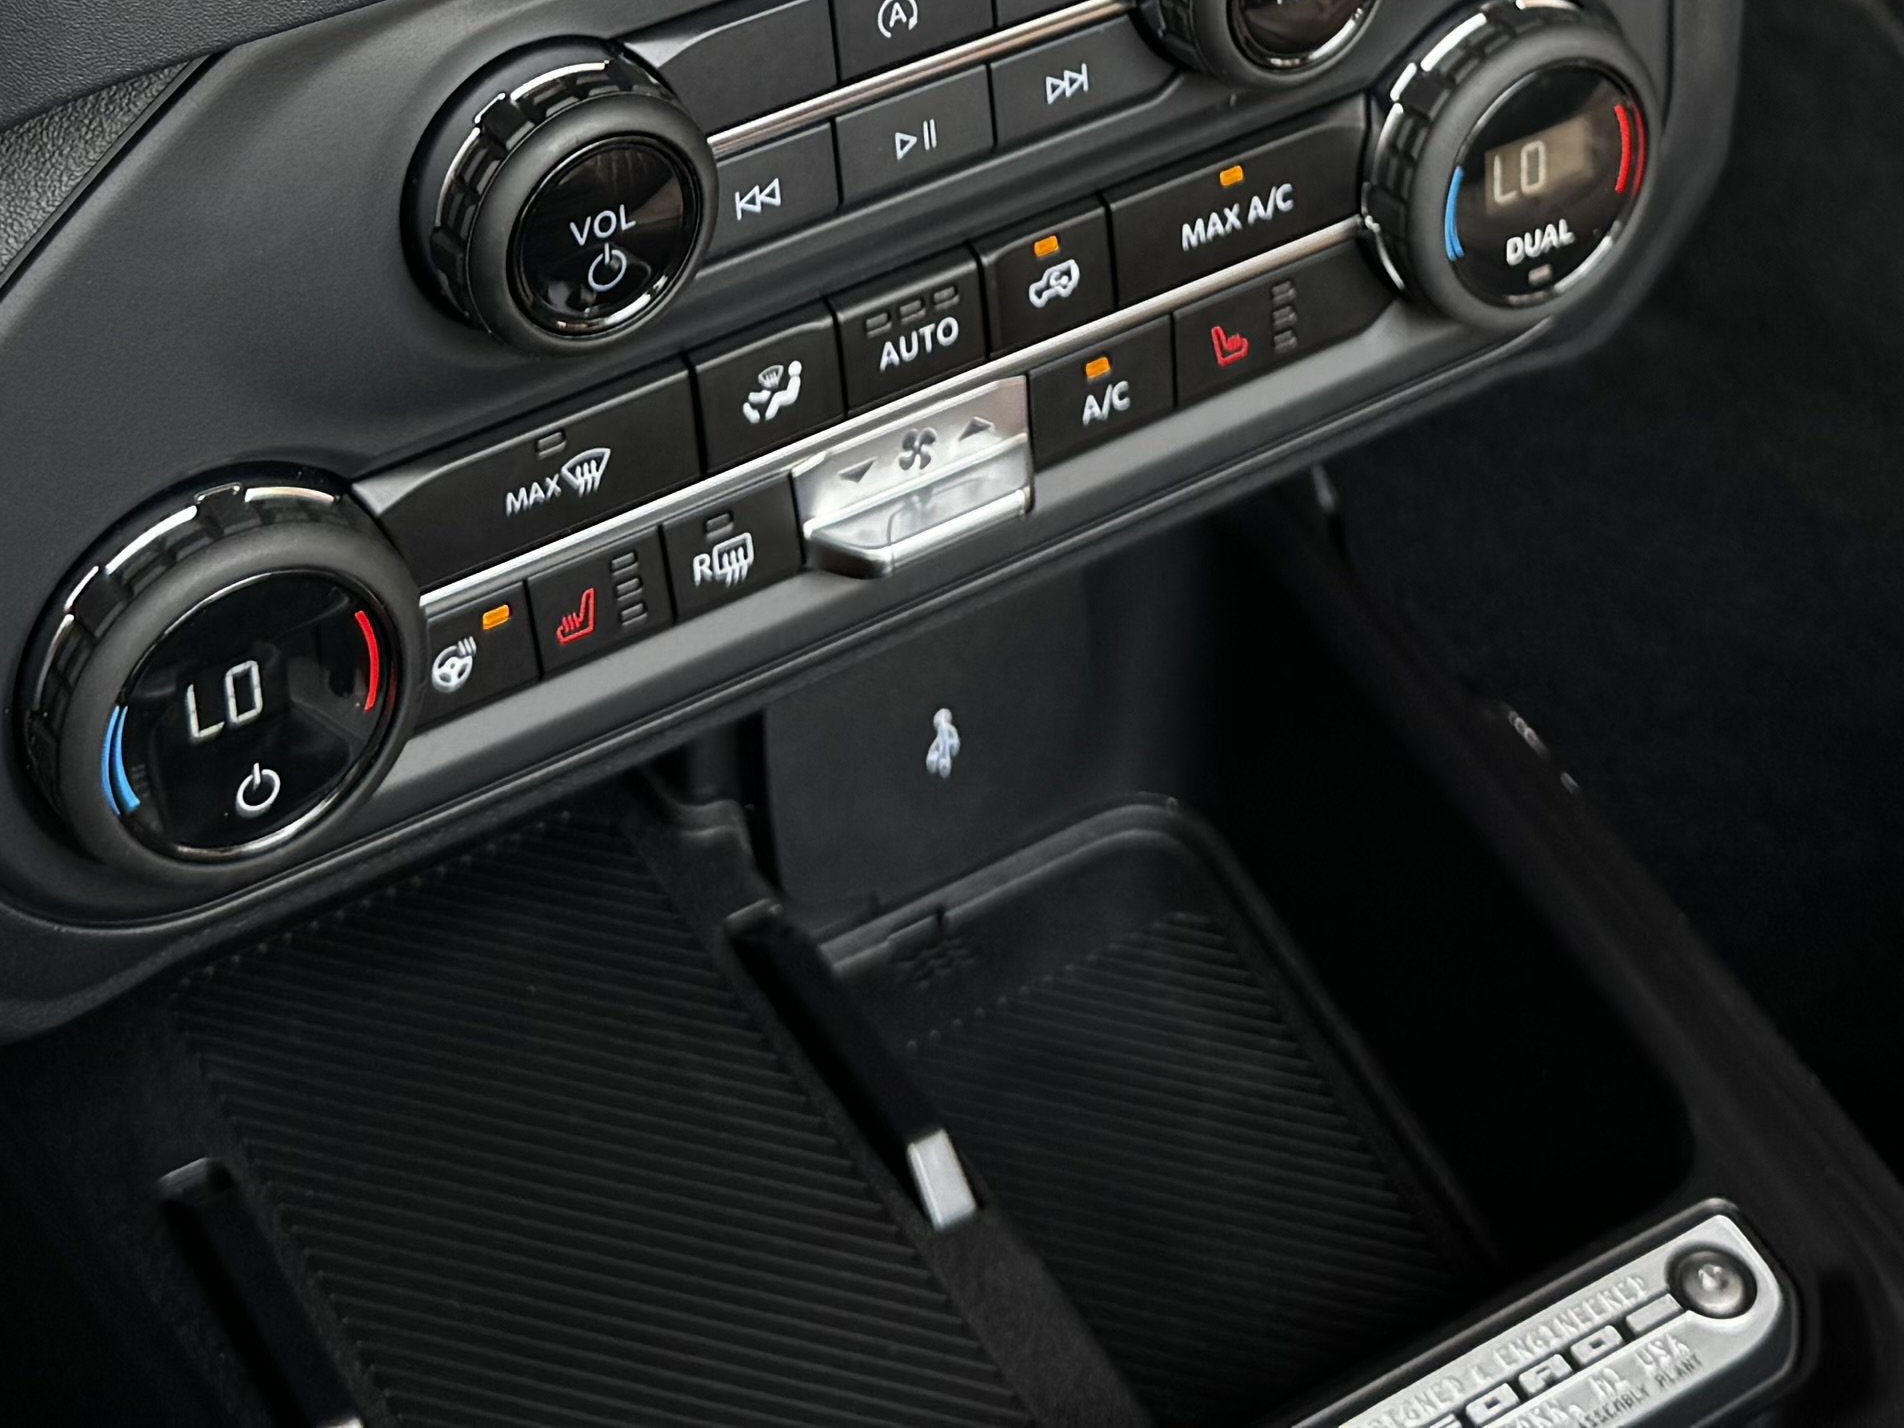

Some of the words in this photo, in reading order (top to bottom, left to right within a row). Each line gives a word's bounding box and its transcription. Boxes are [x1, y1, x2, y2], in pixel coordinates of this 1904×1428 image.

[1492, 140, 1546, 204] LO
[570, 204, 636, 247] VOL
[1180, 202, 1240, 251] MAX
[1247, 184, 1294, 226] A/C
[1505, 218, 1575, 266] DUAL
[879, 316, 959, 372] AUTO
[1082, 380, 1131, 426] A/C
[505, 473, 562, 517] MAX
[186, 660, 263, 741] LO
